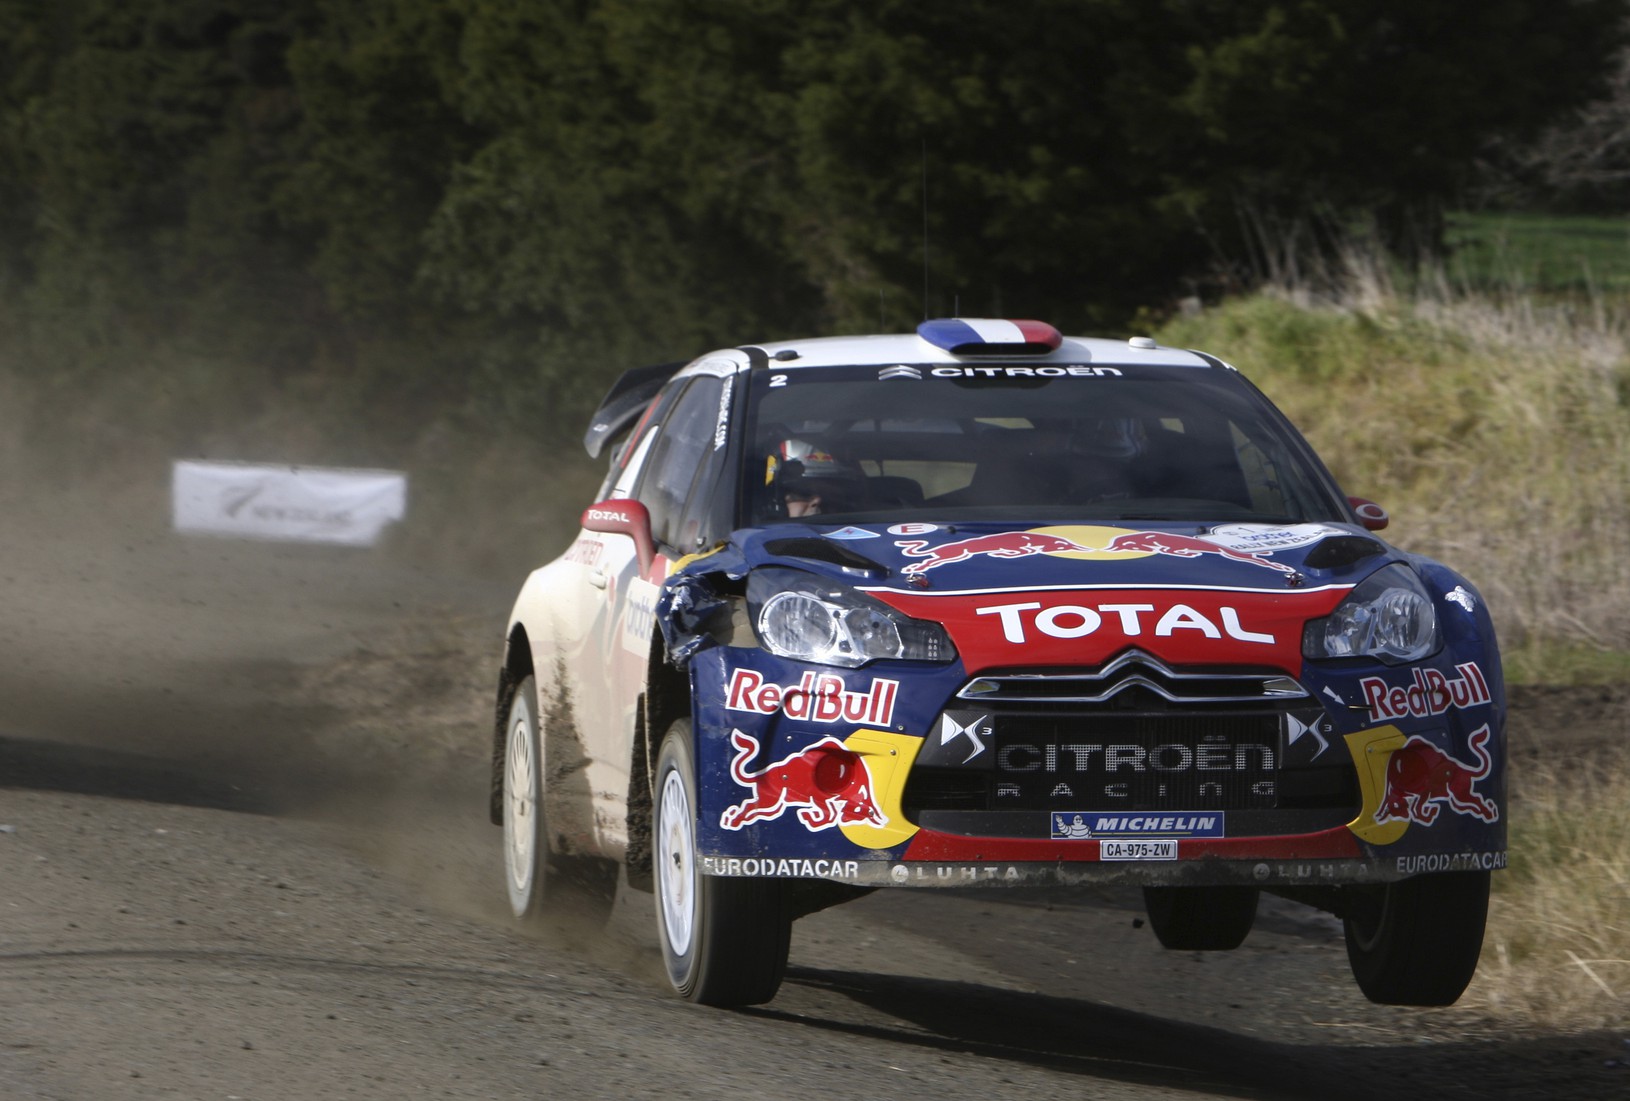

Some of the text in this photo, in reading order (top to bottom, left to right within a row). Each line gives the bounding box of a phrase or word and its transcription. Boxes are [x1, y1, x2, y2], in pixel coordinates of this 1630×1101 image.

[769, 375, 788, 388] 2
[587, 509, 630, 523] TOTAL
[975, 602, 1276, 644] TOTAL
[1095, 817, 1216, 831] MICHELIN
[1107, 843, 1171, 857] CA-975-ZW
[704, 857, 859, 878] EURODATACAR
[1397, 851, 1508, 873] EURODATACAR
[916, 866, 1020, 881] LUHTA
[1278, 863, 1369, 878] LUHTA
